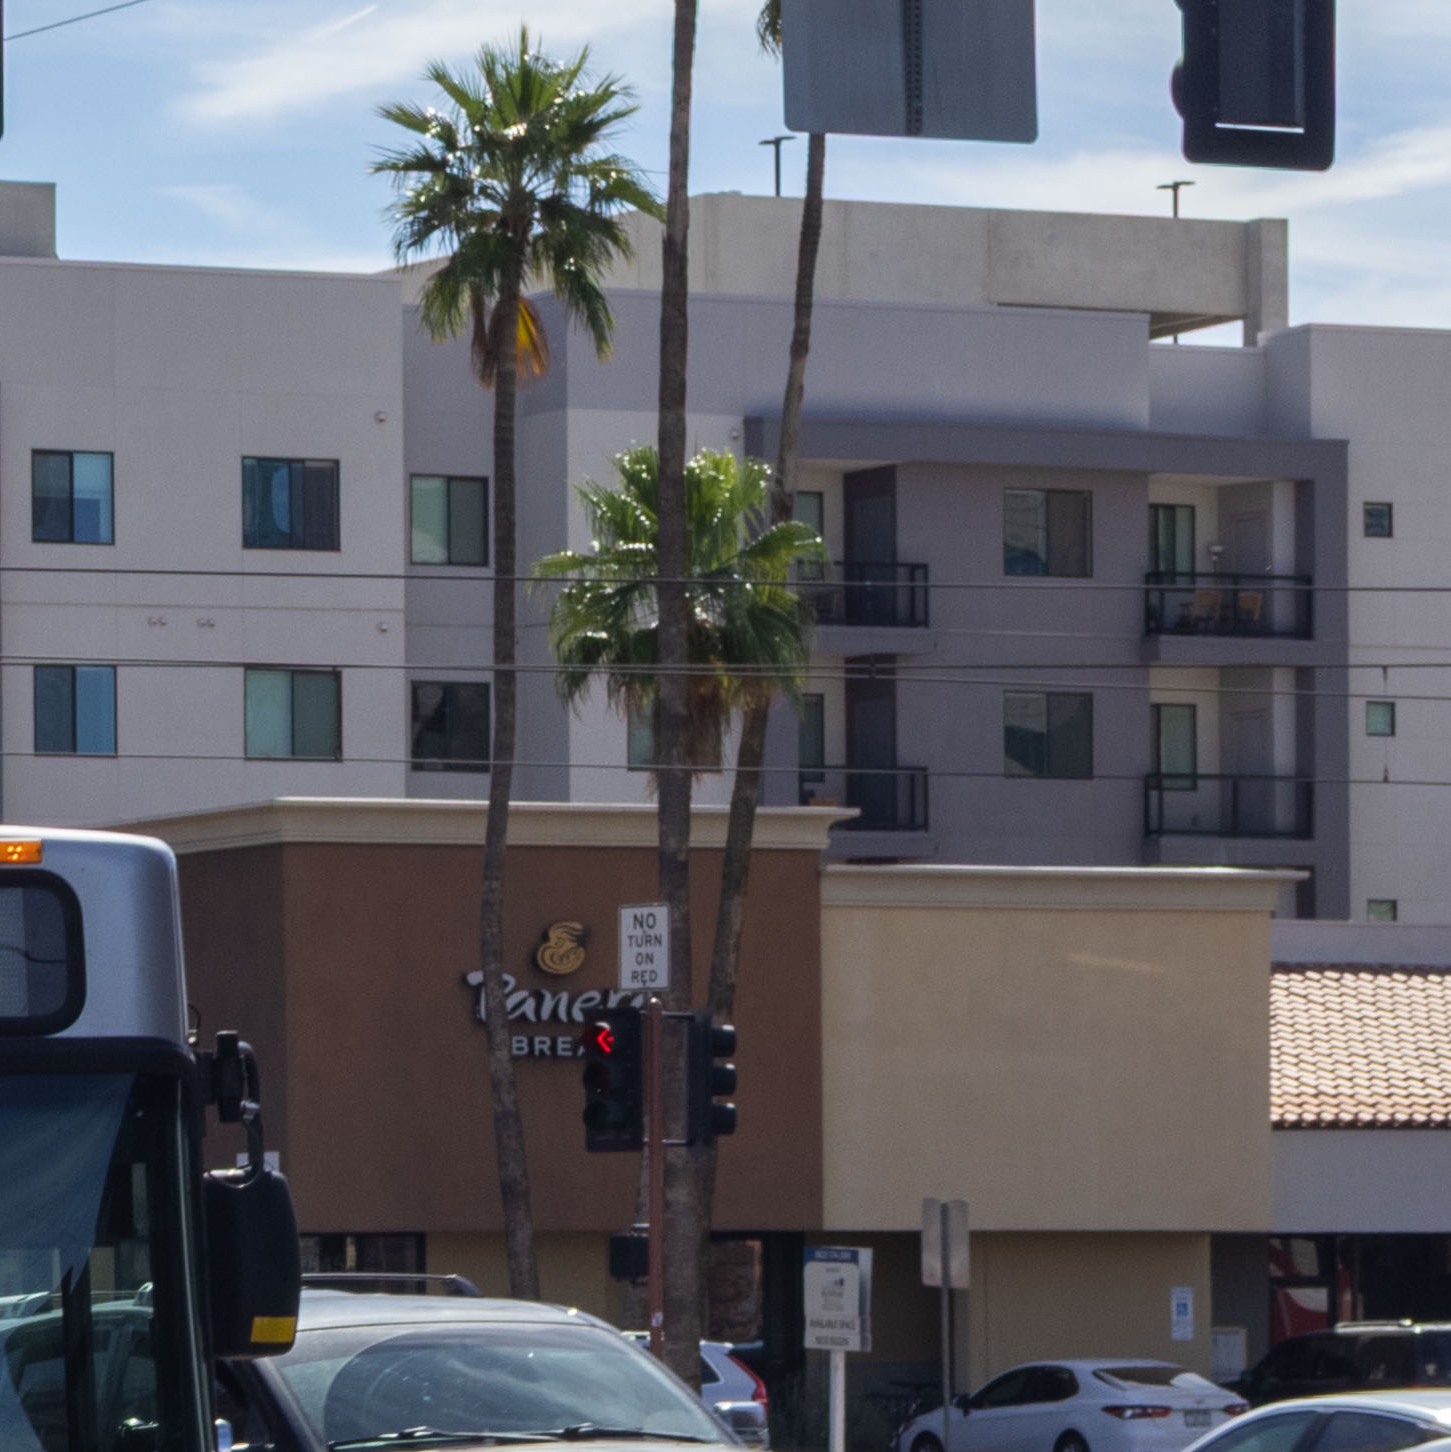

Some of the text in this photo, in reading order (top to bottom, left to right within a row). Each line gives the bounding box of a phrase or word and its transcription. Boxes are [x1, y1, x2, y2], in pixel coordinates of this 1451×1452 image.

[633, 912, 657, 930] NO
[628, 933, 662, 948] TURN
[635, 952, 654, 965] ON
[631, 969, 658, 983] RED
